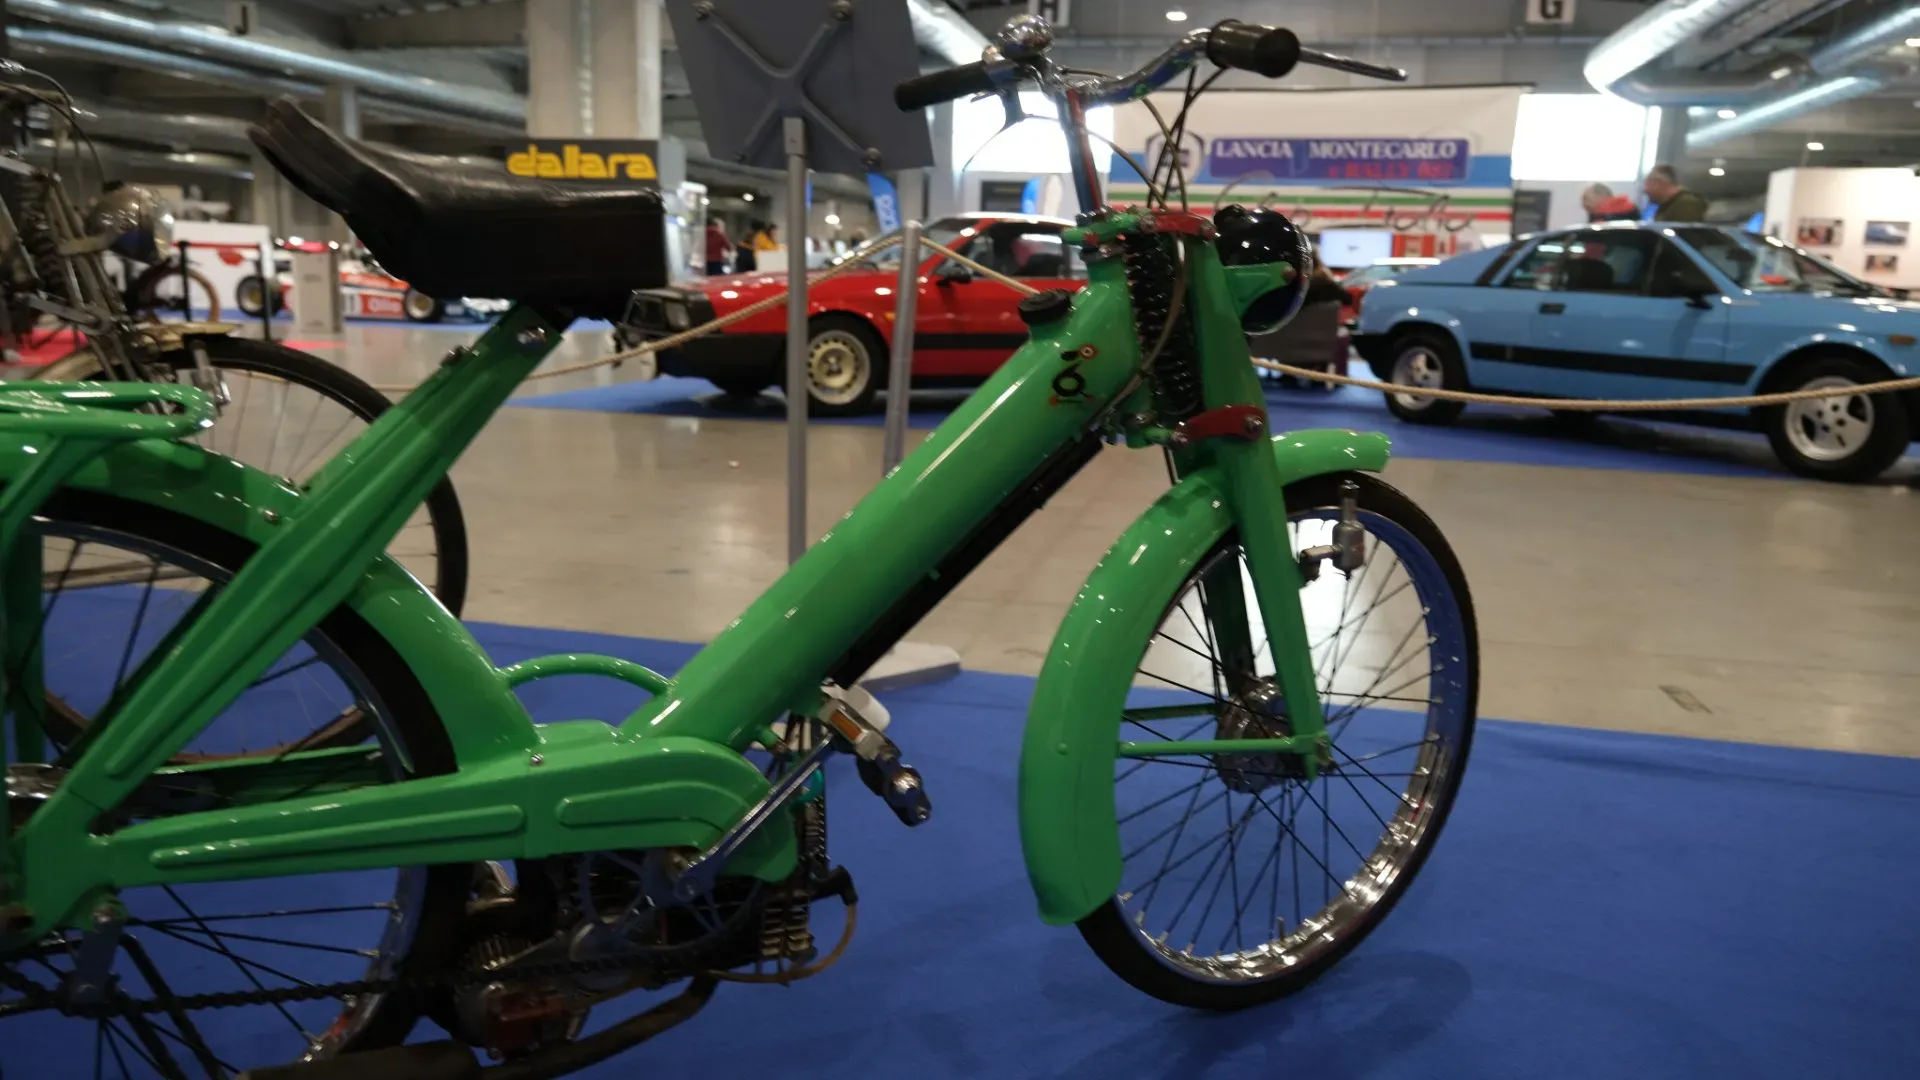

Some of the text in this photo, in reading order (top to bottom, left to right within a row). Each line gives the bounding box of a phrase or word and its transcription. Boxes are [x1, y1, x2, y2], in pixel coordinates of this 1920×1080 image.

[507, 144, 657, 179] dallara
[1216, 141, 1457, 160] LANCIA MONTECARLO
